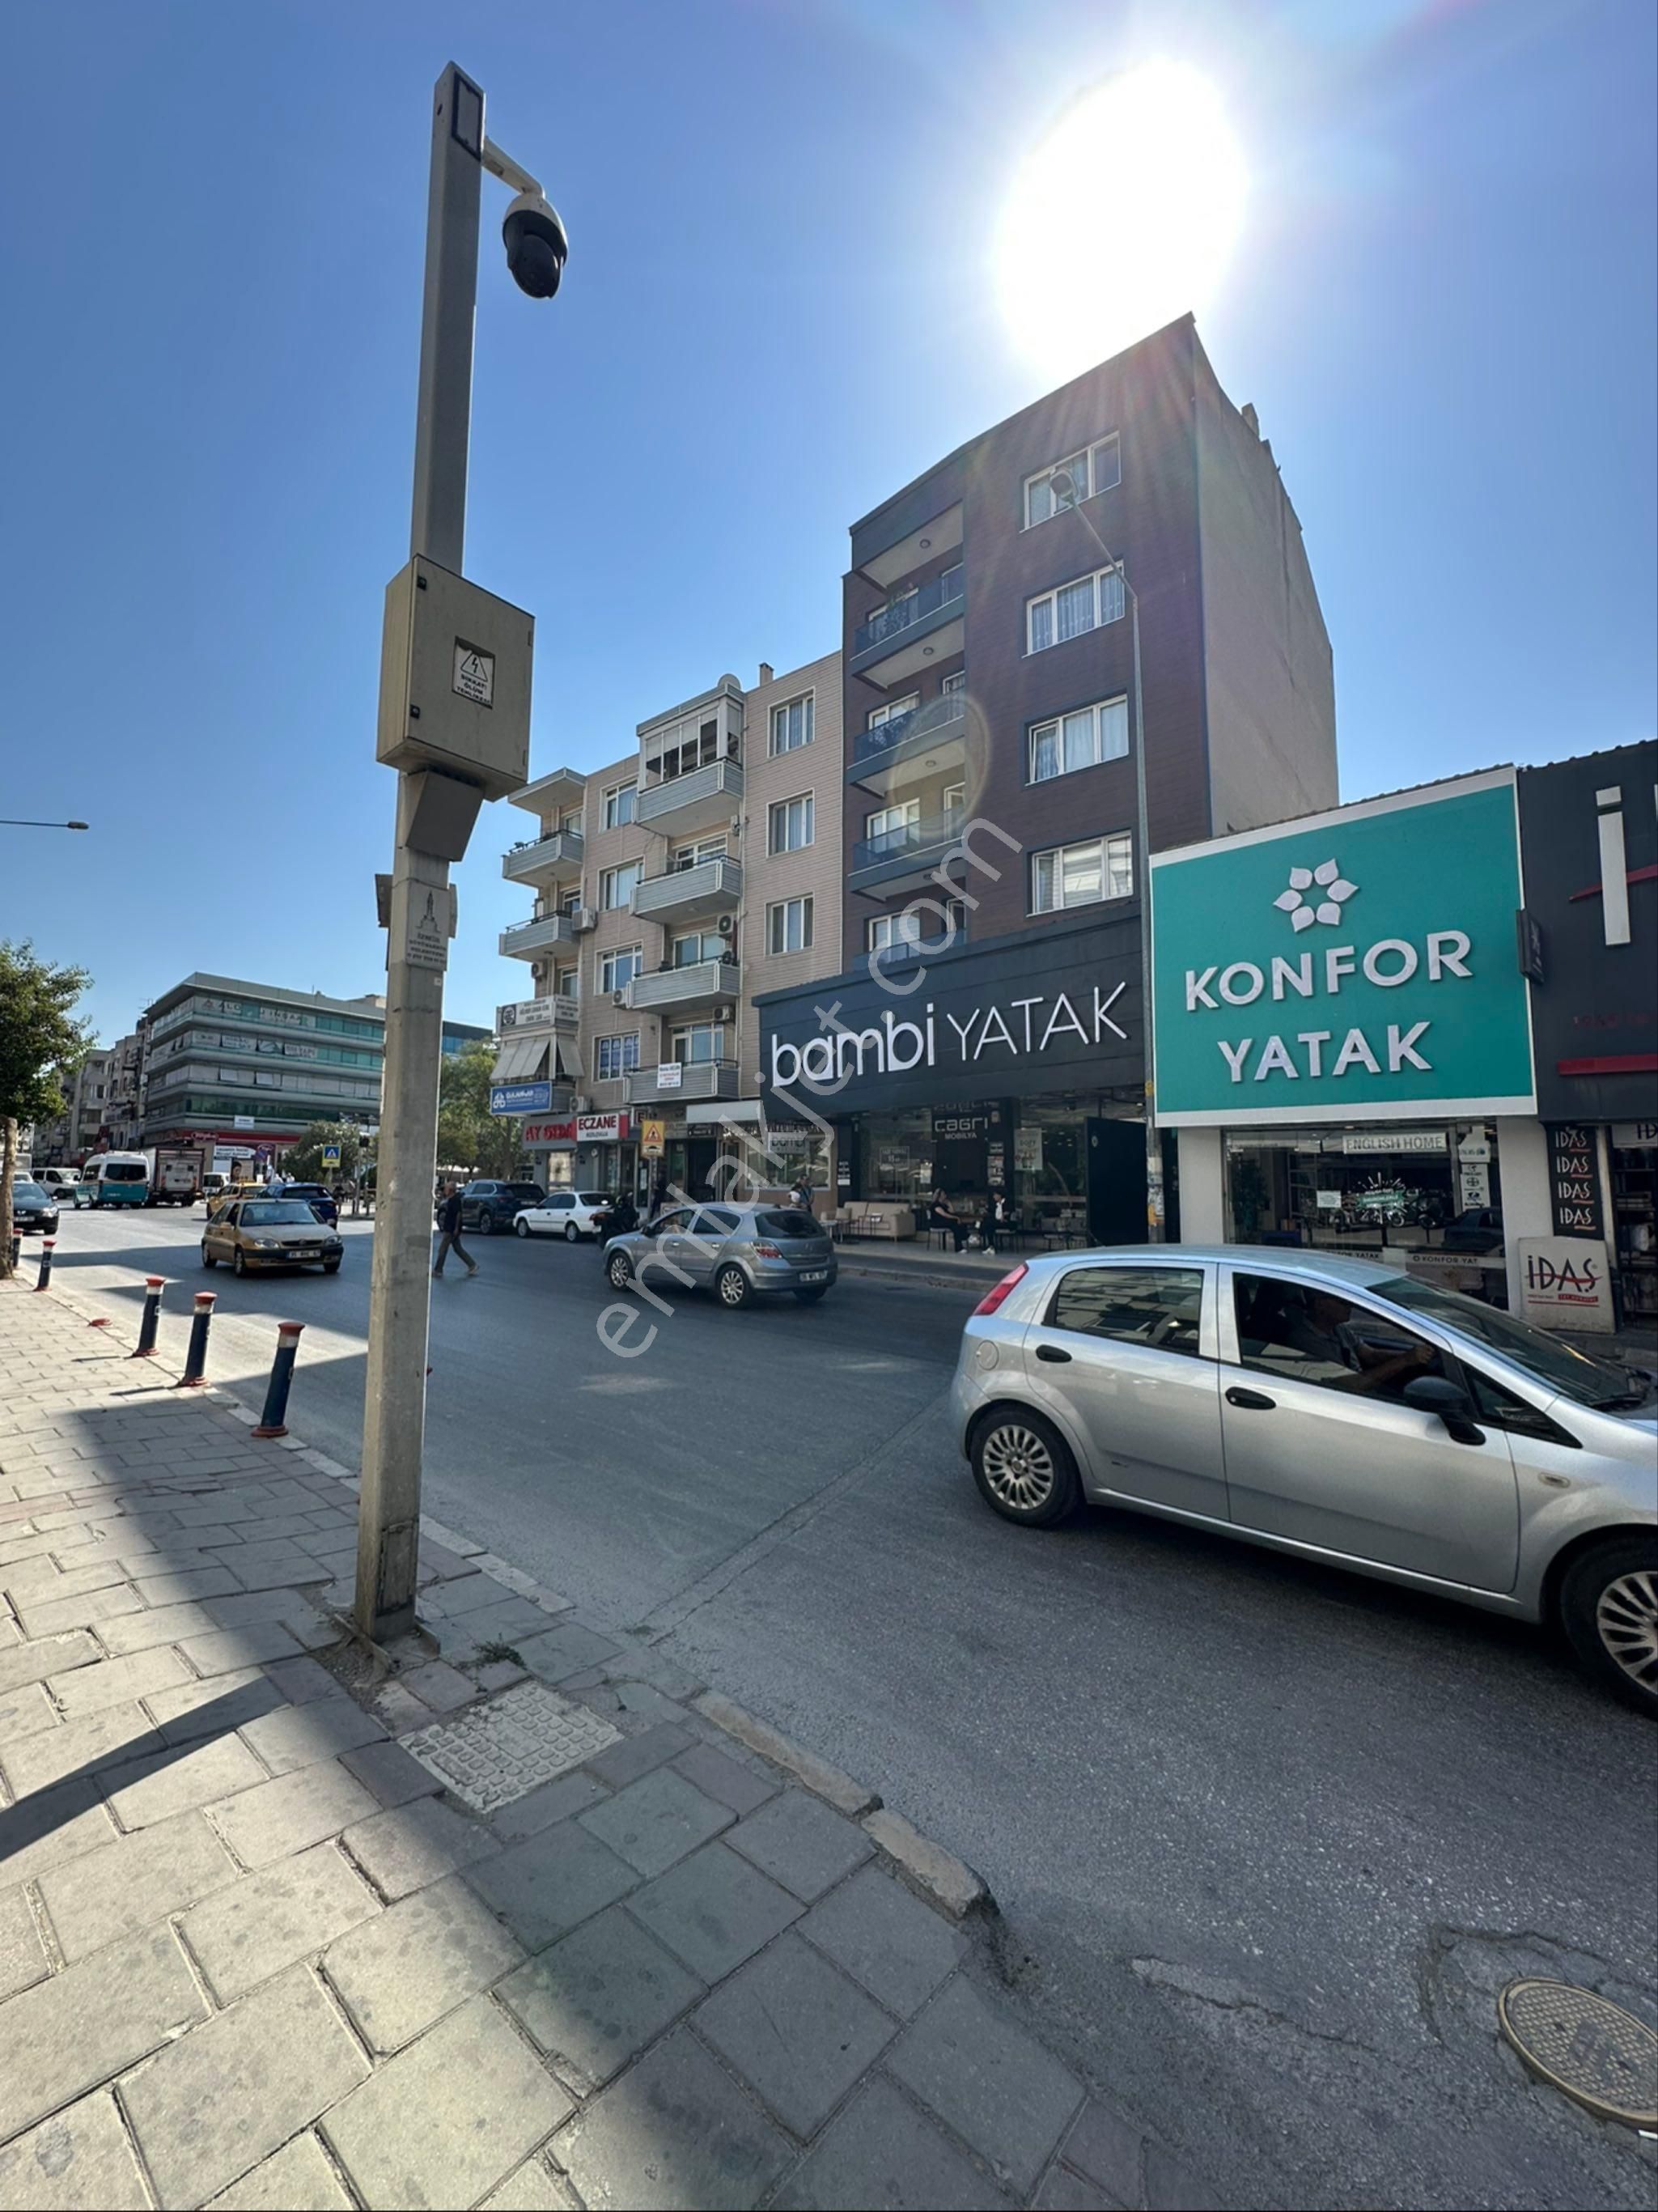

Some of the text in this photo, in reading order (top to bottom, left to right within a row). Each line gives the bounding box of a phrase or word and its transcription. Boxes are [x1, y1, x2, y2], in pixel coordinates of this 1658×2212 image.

[1185, 930, 1473, 1011] KONFOR
[771, 981, 1128, 1087] bambi YATAK
[1218, 1021, 1432, 1082] YATAK
[579, 1115, 617, 1130] ECZANE
[1346, 1136, 1443, 1150] ENGLISH HOME
[1422, 1255, 1458, 1263] KONFOR
